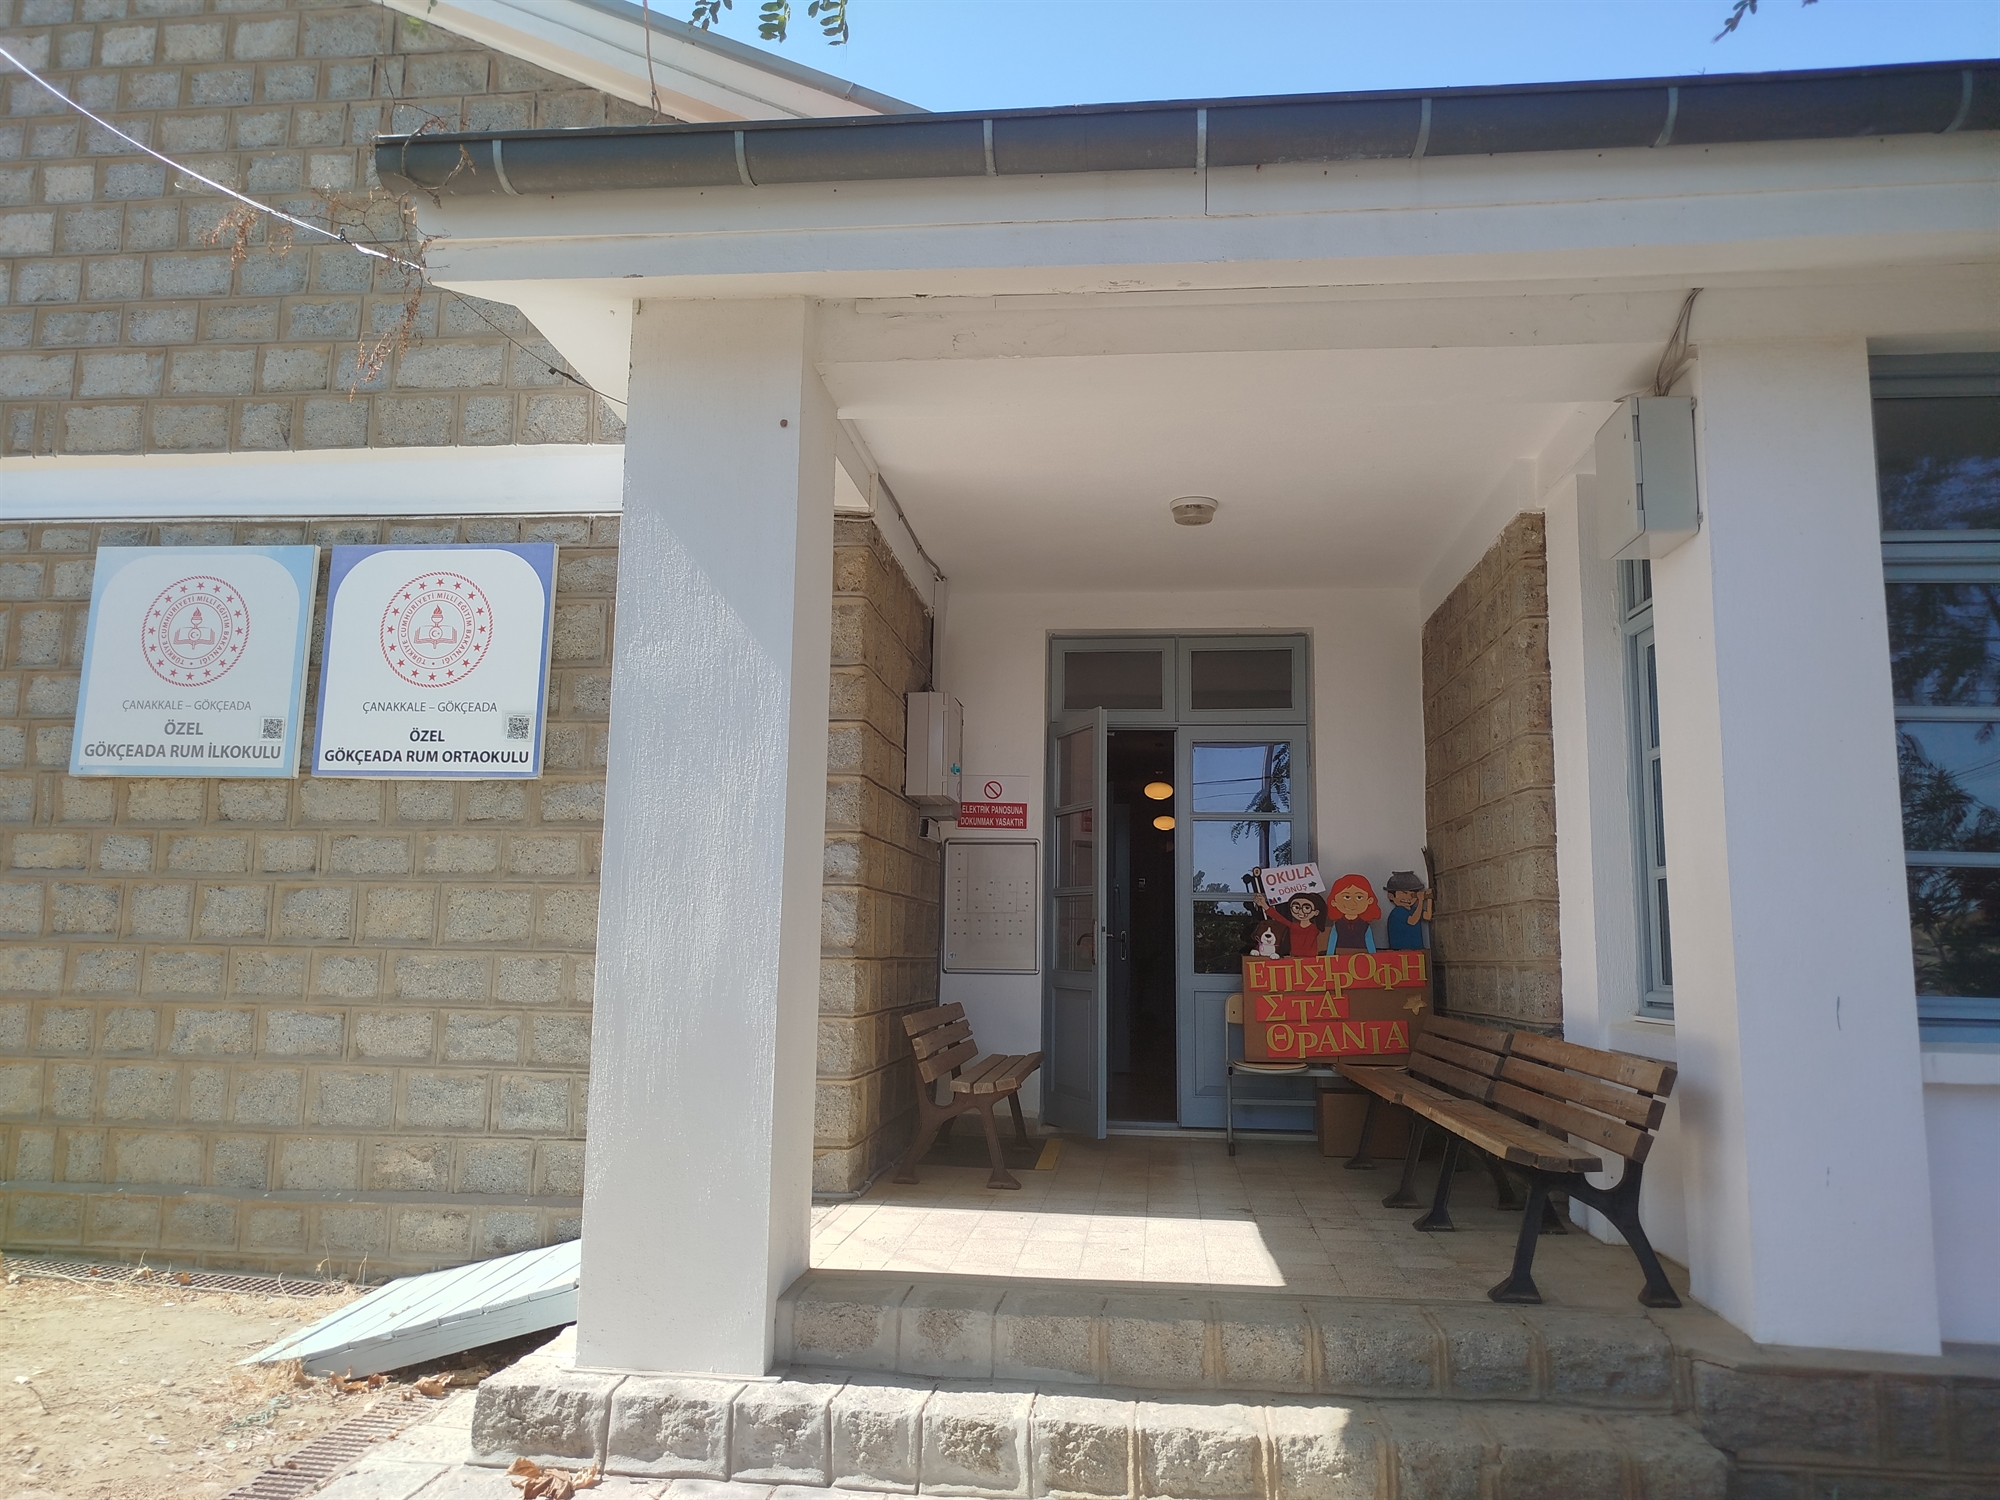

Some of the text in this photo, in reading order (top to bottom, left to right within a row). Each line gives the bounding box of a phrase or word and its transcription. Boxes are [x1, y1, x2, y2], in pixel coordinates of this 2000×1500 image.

[122, 700, 183, 712] ÇANAKKALE
[194, 699, 252, 712] GÖKÇEADA
[362, 701, 426, 714] ÇANAKKALE
[437, 701, 497, 714] GÖKÇEADA
[164, 719, 204, 735] ÖZEL
[409, 727, 445, 742] ÖZEL
[84, 741, 281, 761] GÖKÇEADA RUM İLKOKULU
[324, 748, 529, 766] GÖKÇEADA RUM ORTAOKULU
[962, 804, 1023, 814] ELEKTRİK PANOSUNA
[961, 817, 1024, 826] DOKUNMAK YASAKTIR
[1265, 866, 1314, 886] OKULA
[1278, 883, 1307, 896] DÖNÜŞ
[1246, 953, 1428, 999] ΕΠΙΣΤΡΟΦΗ
[1262, 990, 1342, 1027] ΣΤΑ
[1266, 1021, 1409, 1059] ΘΡΑΝΙΑ
